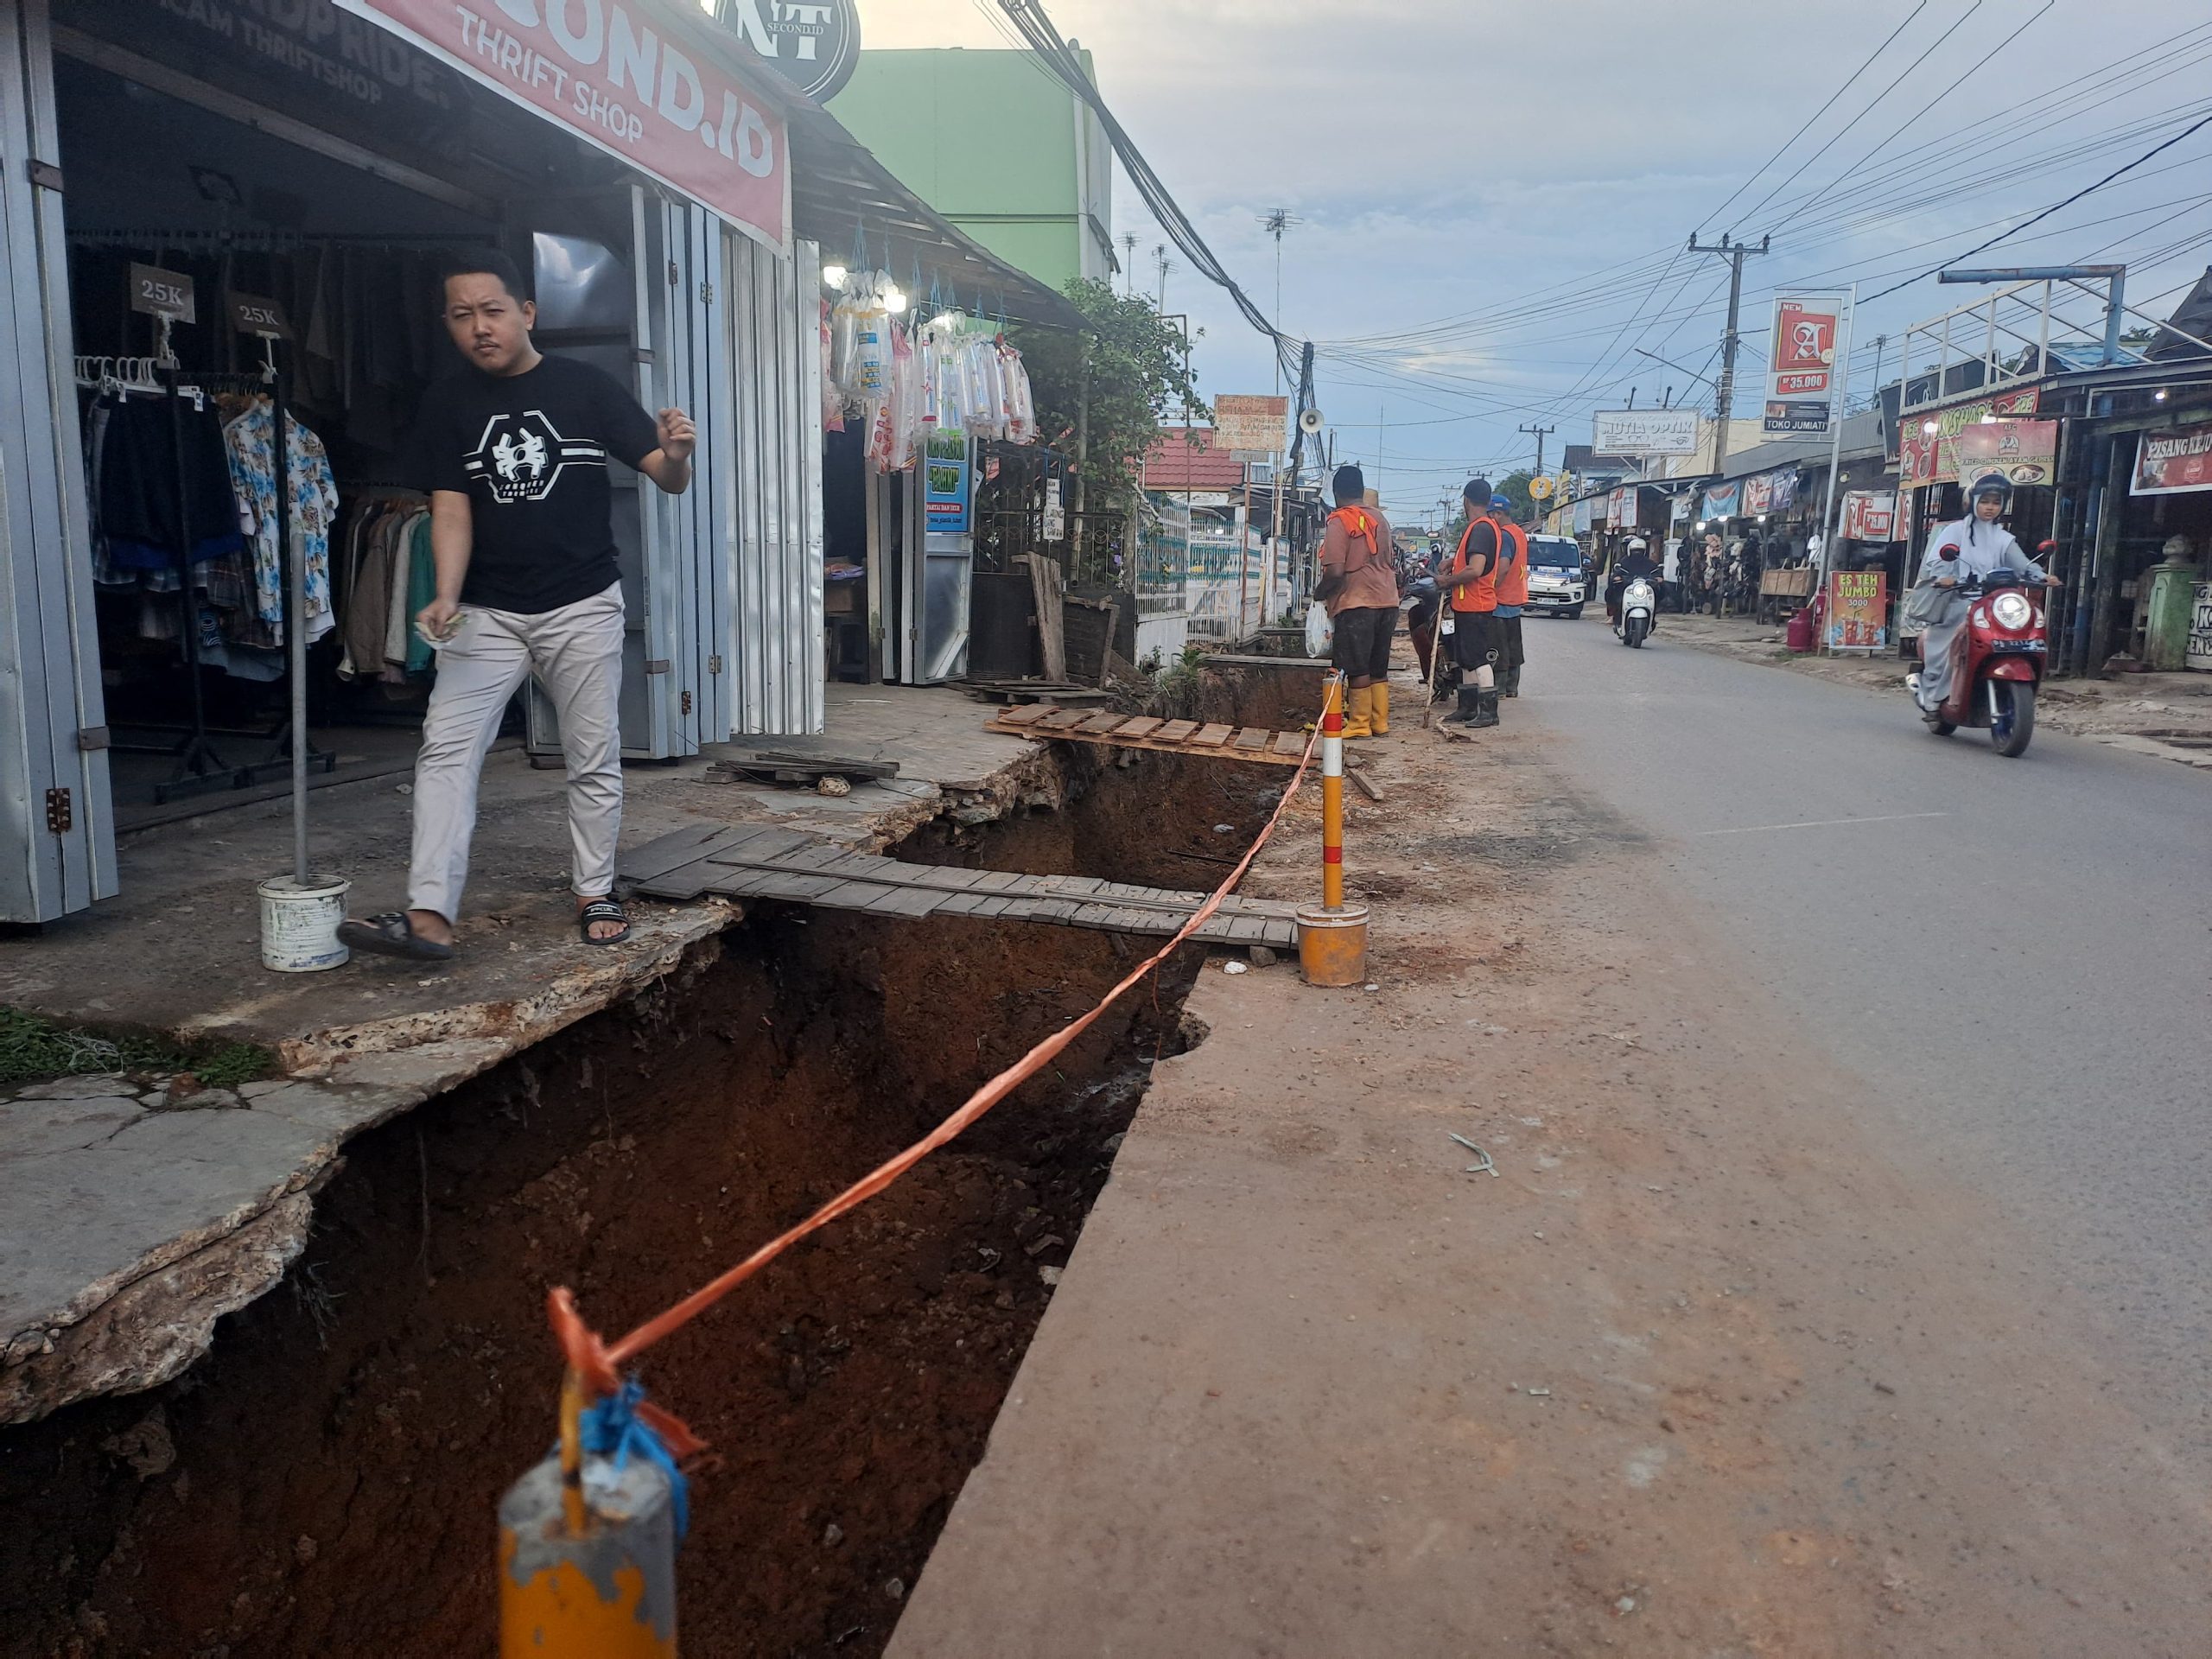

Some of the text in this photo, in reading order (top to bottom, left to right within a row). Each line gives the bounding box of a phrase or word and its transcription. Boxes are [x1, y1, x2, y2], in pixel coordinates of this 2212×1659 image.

[766, 22, 825, 35] SECOND.ID
[239, 16, 383, 105] THRIFTSHOP
[455, 4, 644, 143] THRIFT SHOP
[493, 0, 773, 177] OND.ID
[142, 280, 184, 306] 25K
[239, 305, 280, 326] 25K
[1789, 375, 1823, 389] 35.000
[1767, 420, 1826, 431] TOKO JUMIATI
[2146, 433, 2211, 460] PISANG KEJU
[1839, 574, 1878, 586] ES TEH
[1838, 587, 1878, 598] JUMBO
